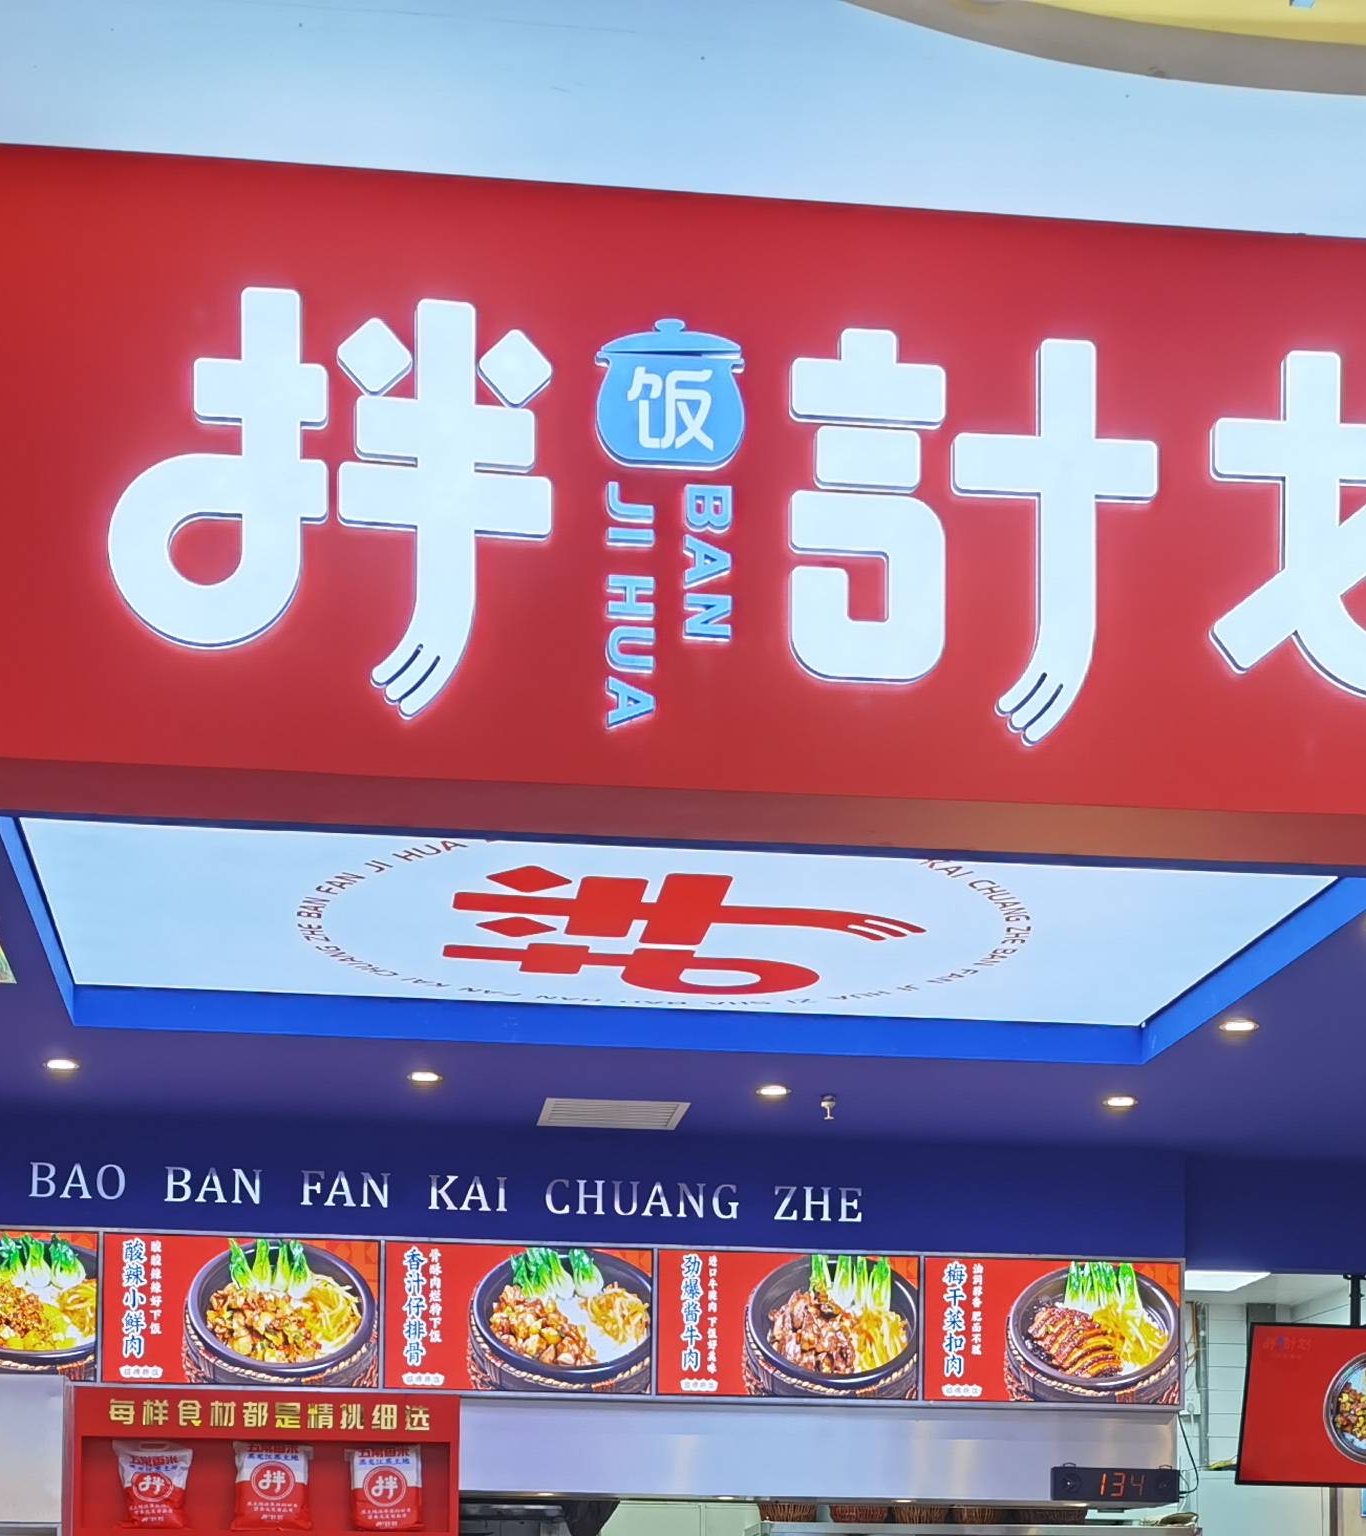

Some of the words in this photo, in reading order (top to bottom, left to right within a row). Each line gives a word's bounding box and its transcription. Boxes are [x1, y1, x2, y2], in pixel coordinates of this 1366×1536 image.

[605, 480, 656, 549] JI
[684, 483, 734, 643] BAN
[605, 574, 657, 731] HUA
[29, 1160, 128, 1202] BAO
[163, 1165, 263, 1207] BAN
[300, 1169, 391, 1209] FAN
[427, 1173, 508, 1214] KAI
[544, 1178, 740, 1221] CHUANG
[774, 1185, 863, 1225] ZHE
[122, 1238, 148, 1359] 酸辣小鲜肉
[402, 1246, 429, 1367] 香汁仔排骨
[680, 1253, 704, 1372] 劲爆酱牛肉
[942, 1261, 968, 1378] 梅干菜扣肉
[108, 1398, 431, 1431] 每样食材都是精挑细选
[258, 1470, 287, 1494] 拌
[370, 1475, 398, 1500] 拌
[1099, 1471, 1146, 1497] 134
